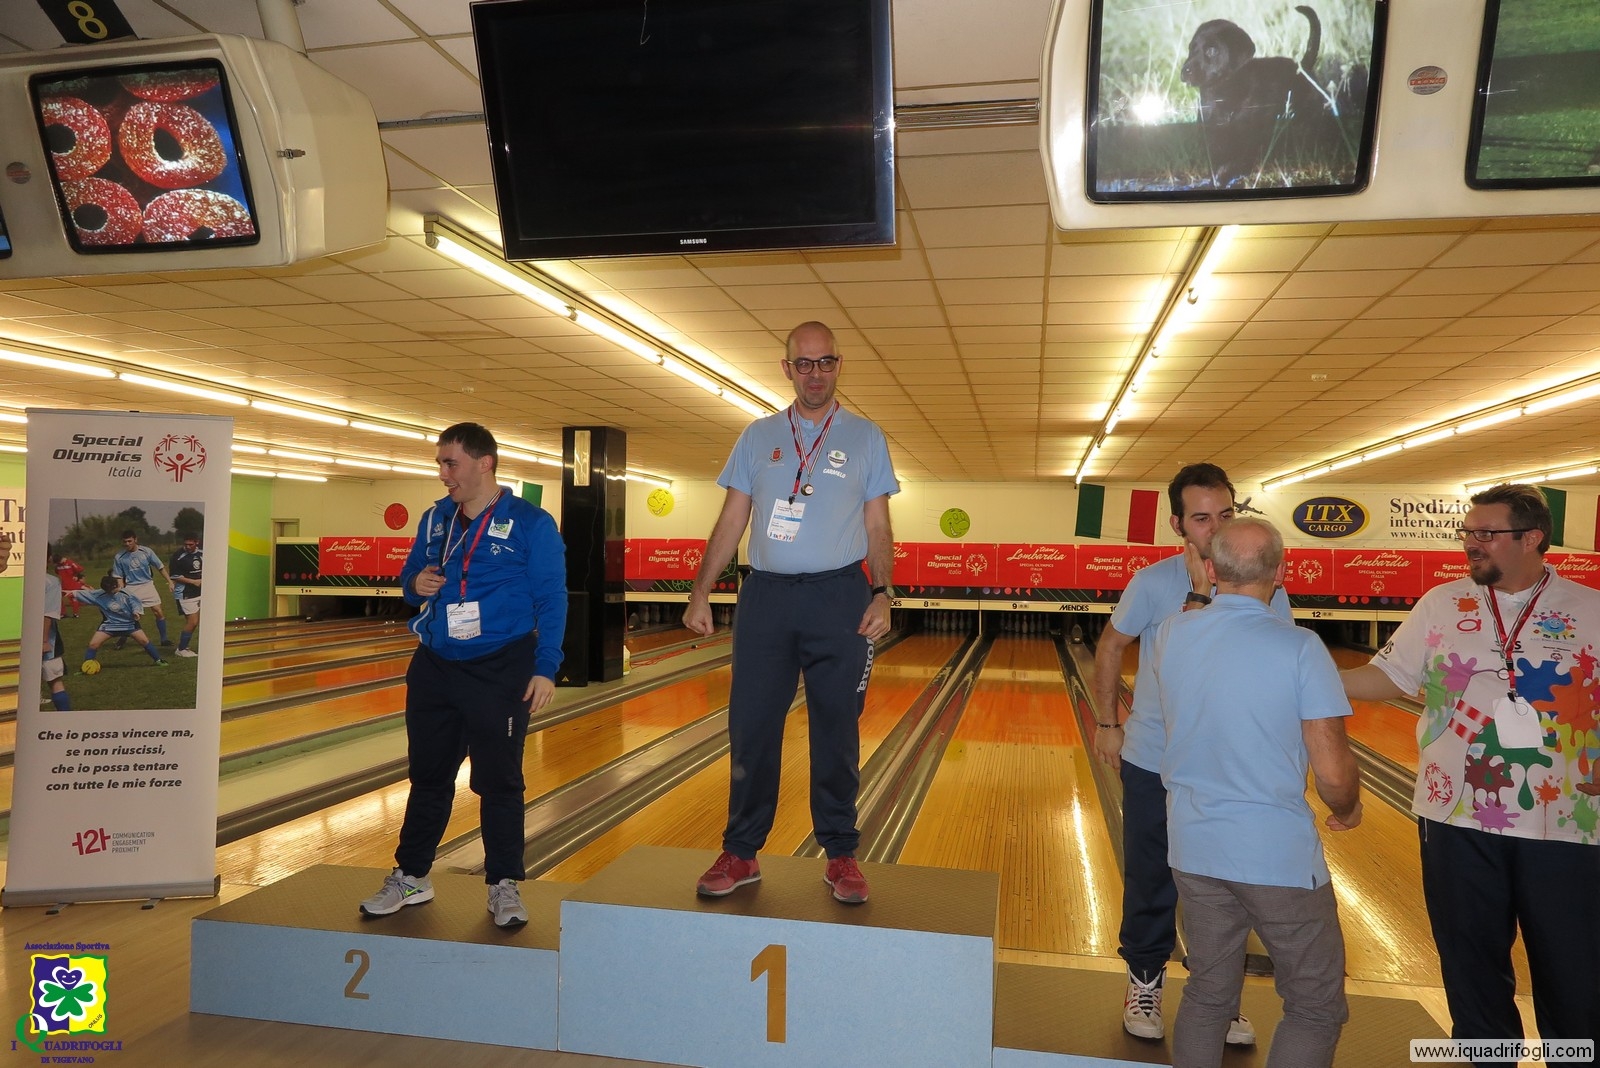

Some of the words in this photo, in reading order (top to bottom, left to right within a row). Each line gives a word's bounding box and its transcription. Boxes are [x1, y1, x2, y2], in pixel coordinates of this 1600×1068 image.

[67, 0, 108, 39] 8
[71, 433, 143, 447] Special
[52, 448, 142, 463] Olympics
[108, 466, 142, 478] Italia
[1305, 504, 1357, 521] ITX
[1390, 498, 1472, 518] Spedizio
[1308, 524, 1347, 532] CARGO
[1390, 516, 1464, 529] internazio
[326, 541, 372, 552] Lombardia
[1006, 548, 1067, 561] Lombardia
[1093, 556, 1123, 564] Special
[1344, 554, 1412, 568] Lombardia
[1086, 563, 1123, 572] Olympics
[1442, 563, 1470, 571] Specia
[38, 730, 63, 740] Che
[66, 729, 78, 740] io
[81, 730, 119, 741] possa
[122, 728, 168, 738] vincere
[171, 730, 194, 739] ma,
[66, 748, 80, 757] se
[83, 747, 109, 756] non
[111, 745, 166, 756] riuscissi,
[51, 764, 74, 774] che
[77, 763, 90, 773] io
[93, 764, 130, 775] possa
[133, 762, 178, 772] tentare
[46, 782, 70, 791] con
[73, 780, 104, 790] tutte
[107, 779, 119, 789] le
[122, 778, 146, 788] mie
[149, 778, 182, 788] forze
[112, 831, 155, 839] COMMUNICATION
[344, 948, 370, 1000] 2
[751, 944, 787, 1043] 1
